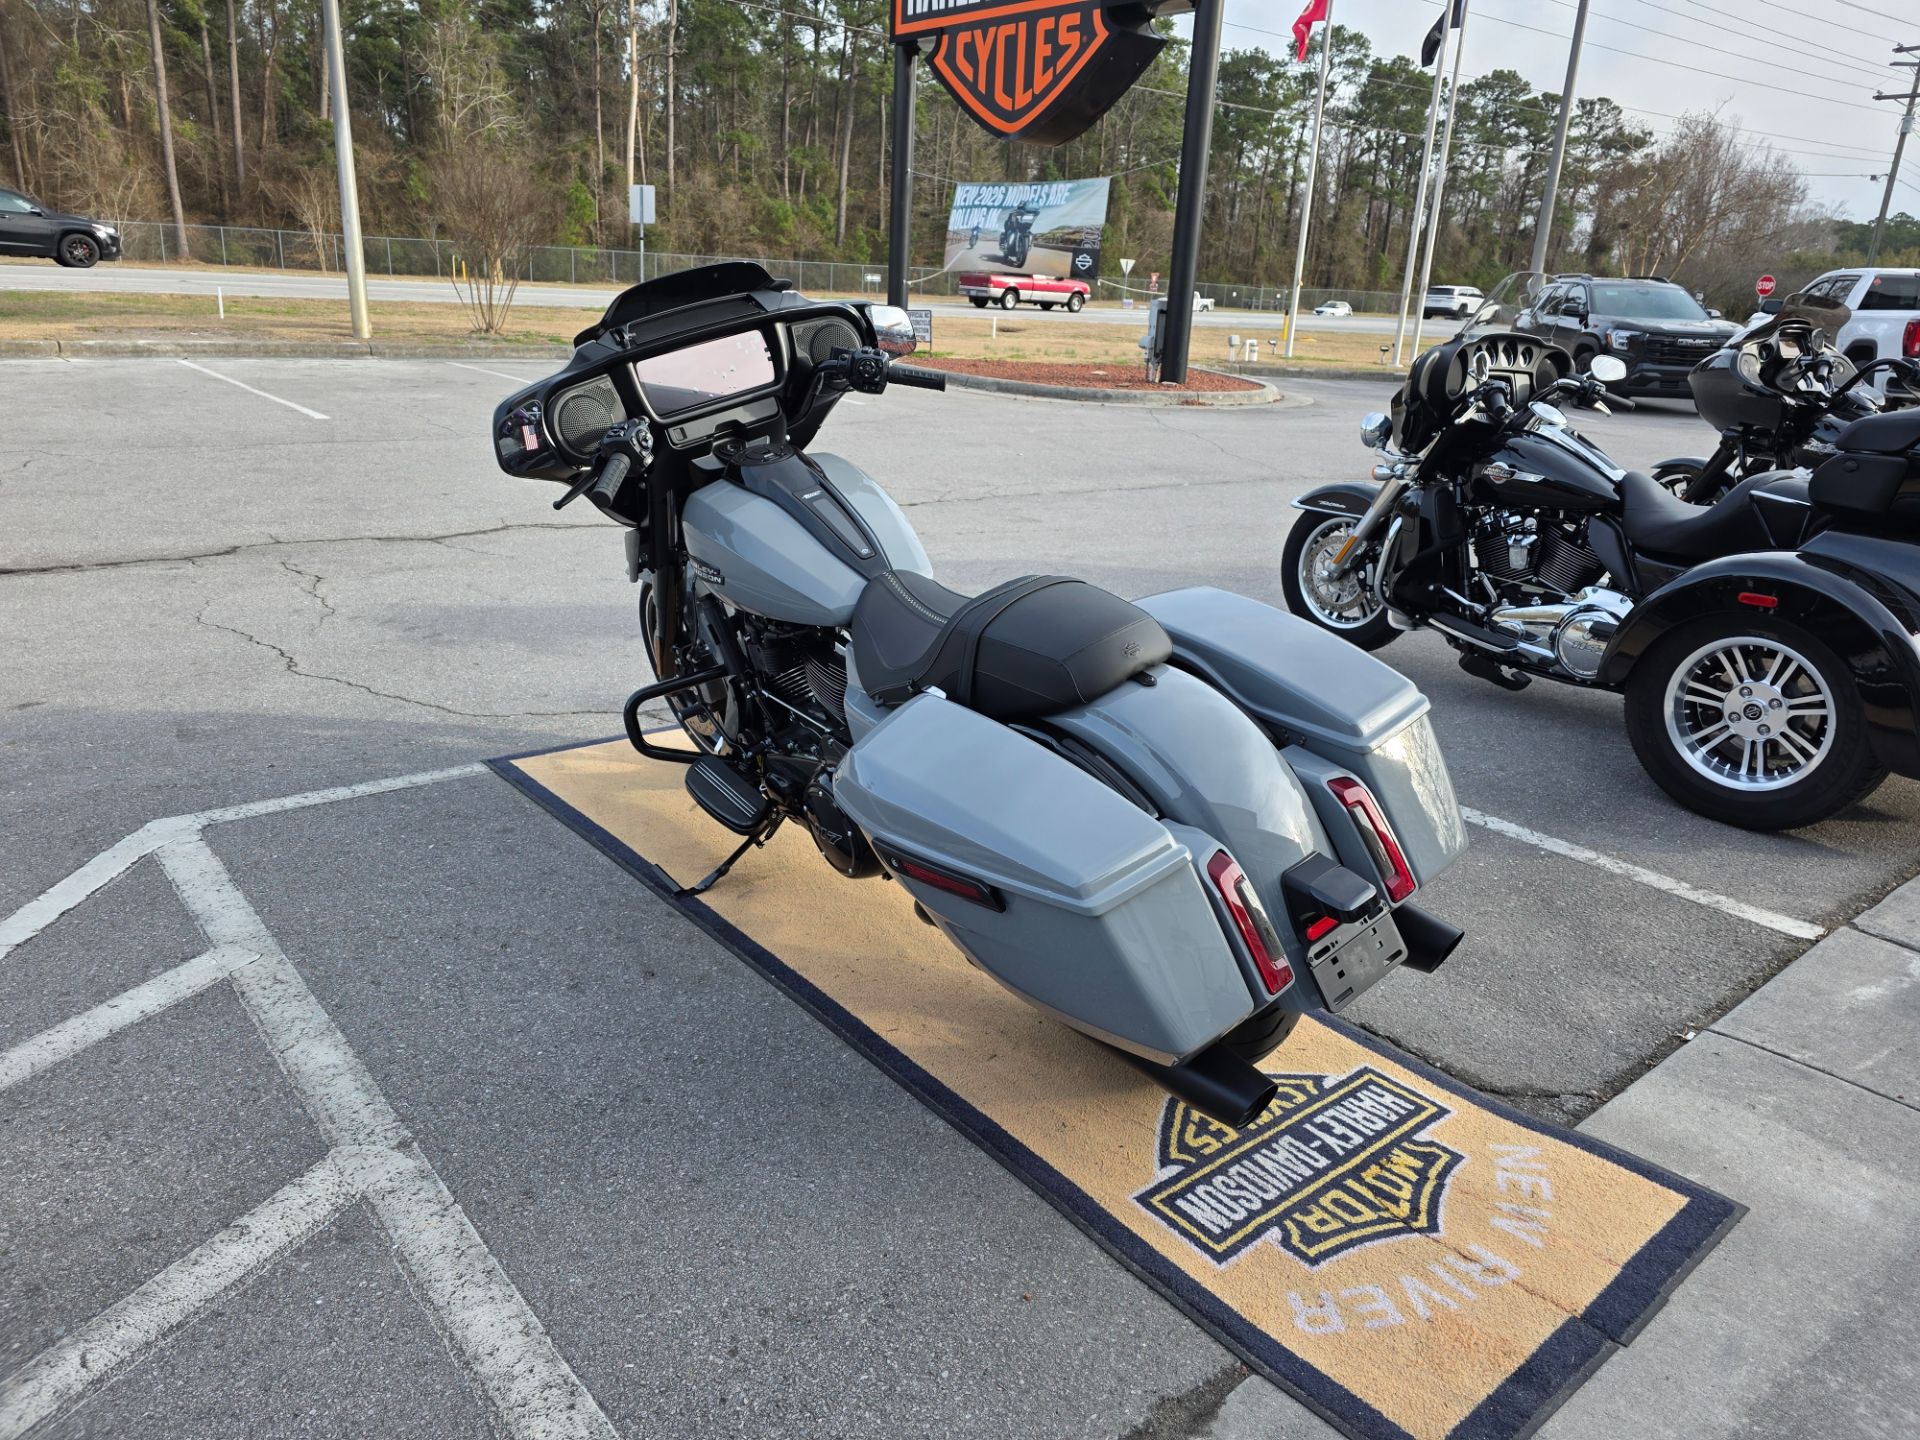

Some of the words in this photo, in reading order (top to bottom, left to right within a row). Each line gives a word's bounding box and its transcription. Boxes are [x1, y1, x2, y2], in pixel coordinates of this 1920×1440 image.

[955, 12, 1081, 111] CYCLES
[948, 208, 987, 230] ROLLING
[953, 185, 977, 207] NEW
[974, 185, 1006, 206] 2026
[1003, 184, 1047, 206] MODELS
[1046, 183, 1072, 205] ARE
[1757, 281, 1774, 290] STOP
[1174, 1084, 1416, 1235] HARLEY-DAVIDSON
[1184, 1086, 1308, 1156] CYES
[1292, 1146, 1426, 1234] MOTOR
[1488, 1143, 1553, 1249] NEW
[1286, 1242, 1522, 1335] RIVER
